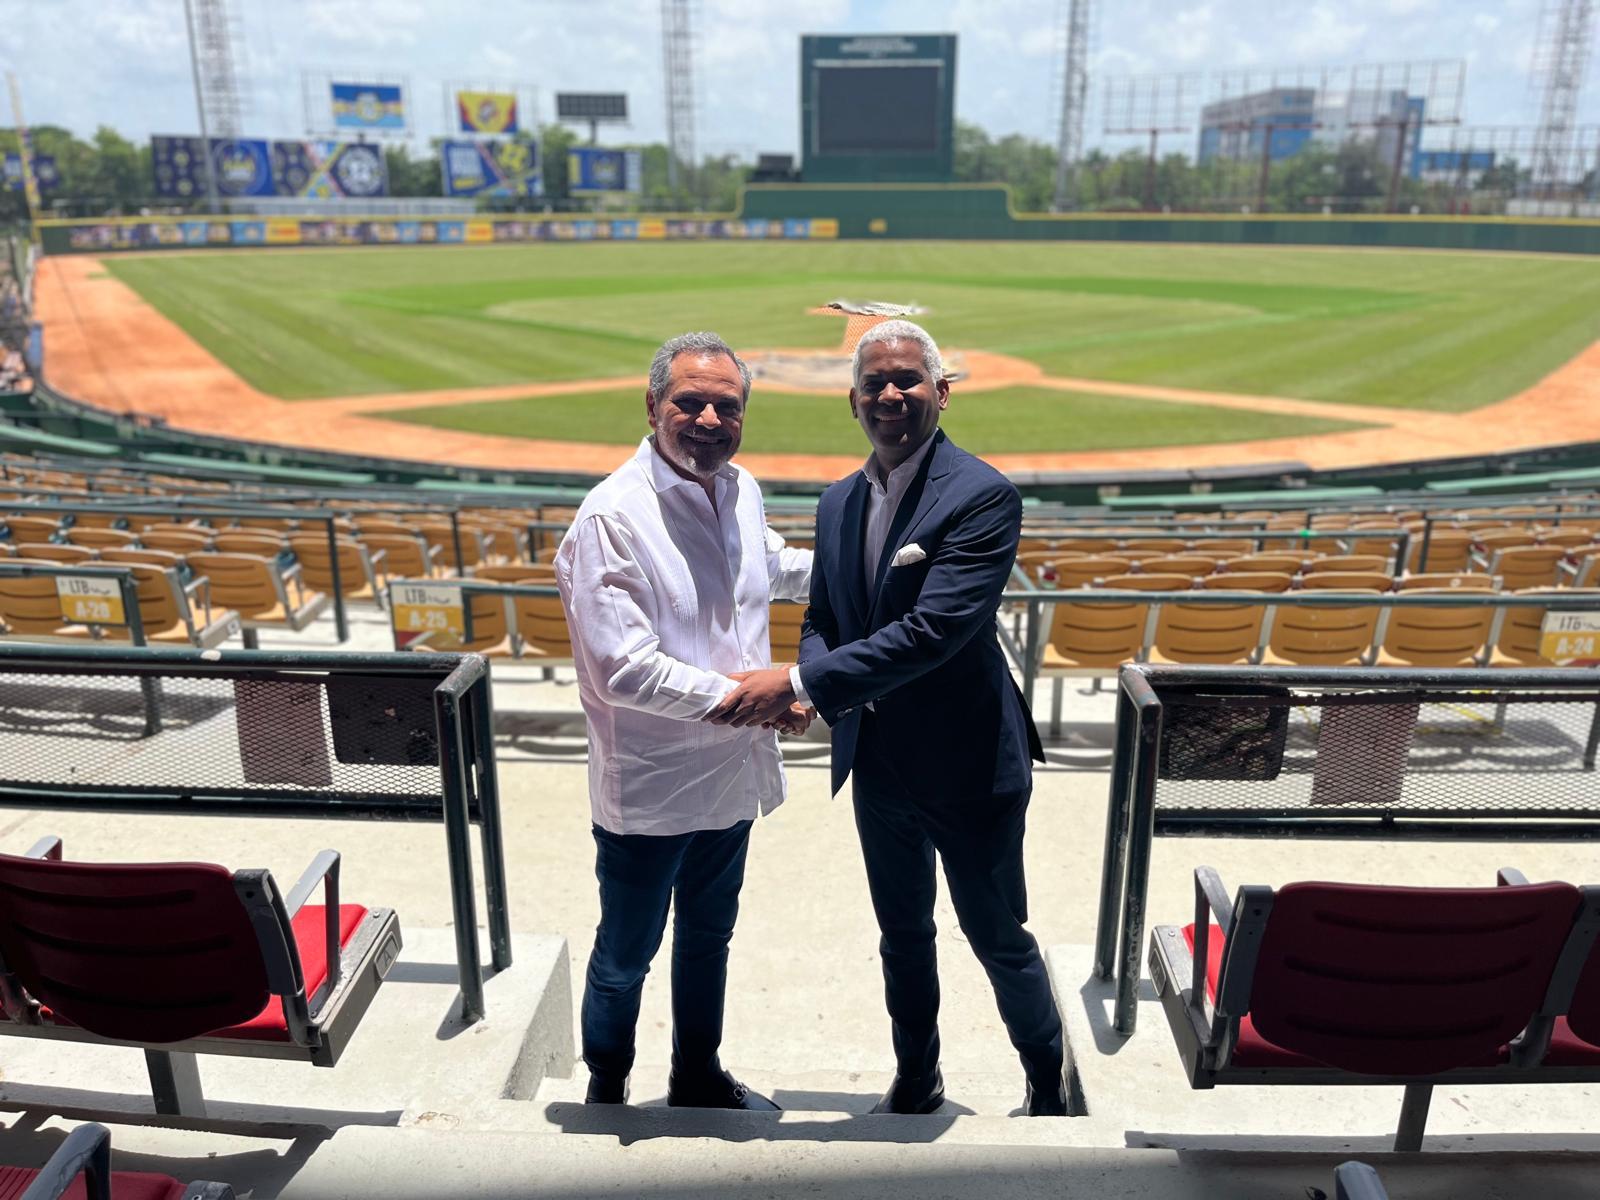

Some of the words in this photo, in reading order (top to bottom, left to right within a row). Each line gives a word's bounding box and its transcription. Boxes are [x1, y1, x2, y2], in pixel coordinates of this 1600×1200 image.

[69, 579, 89, 594] LTB
[405, 588, 426, 604] LTB
[410, 609, 448, 629] A-25
[1555, 637, 1595, 656] A-24
